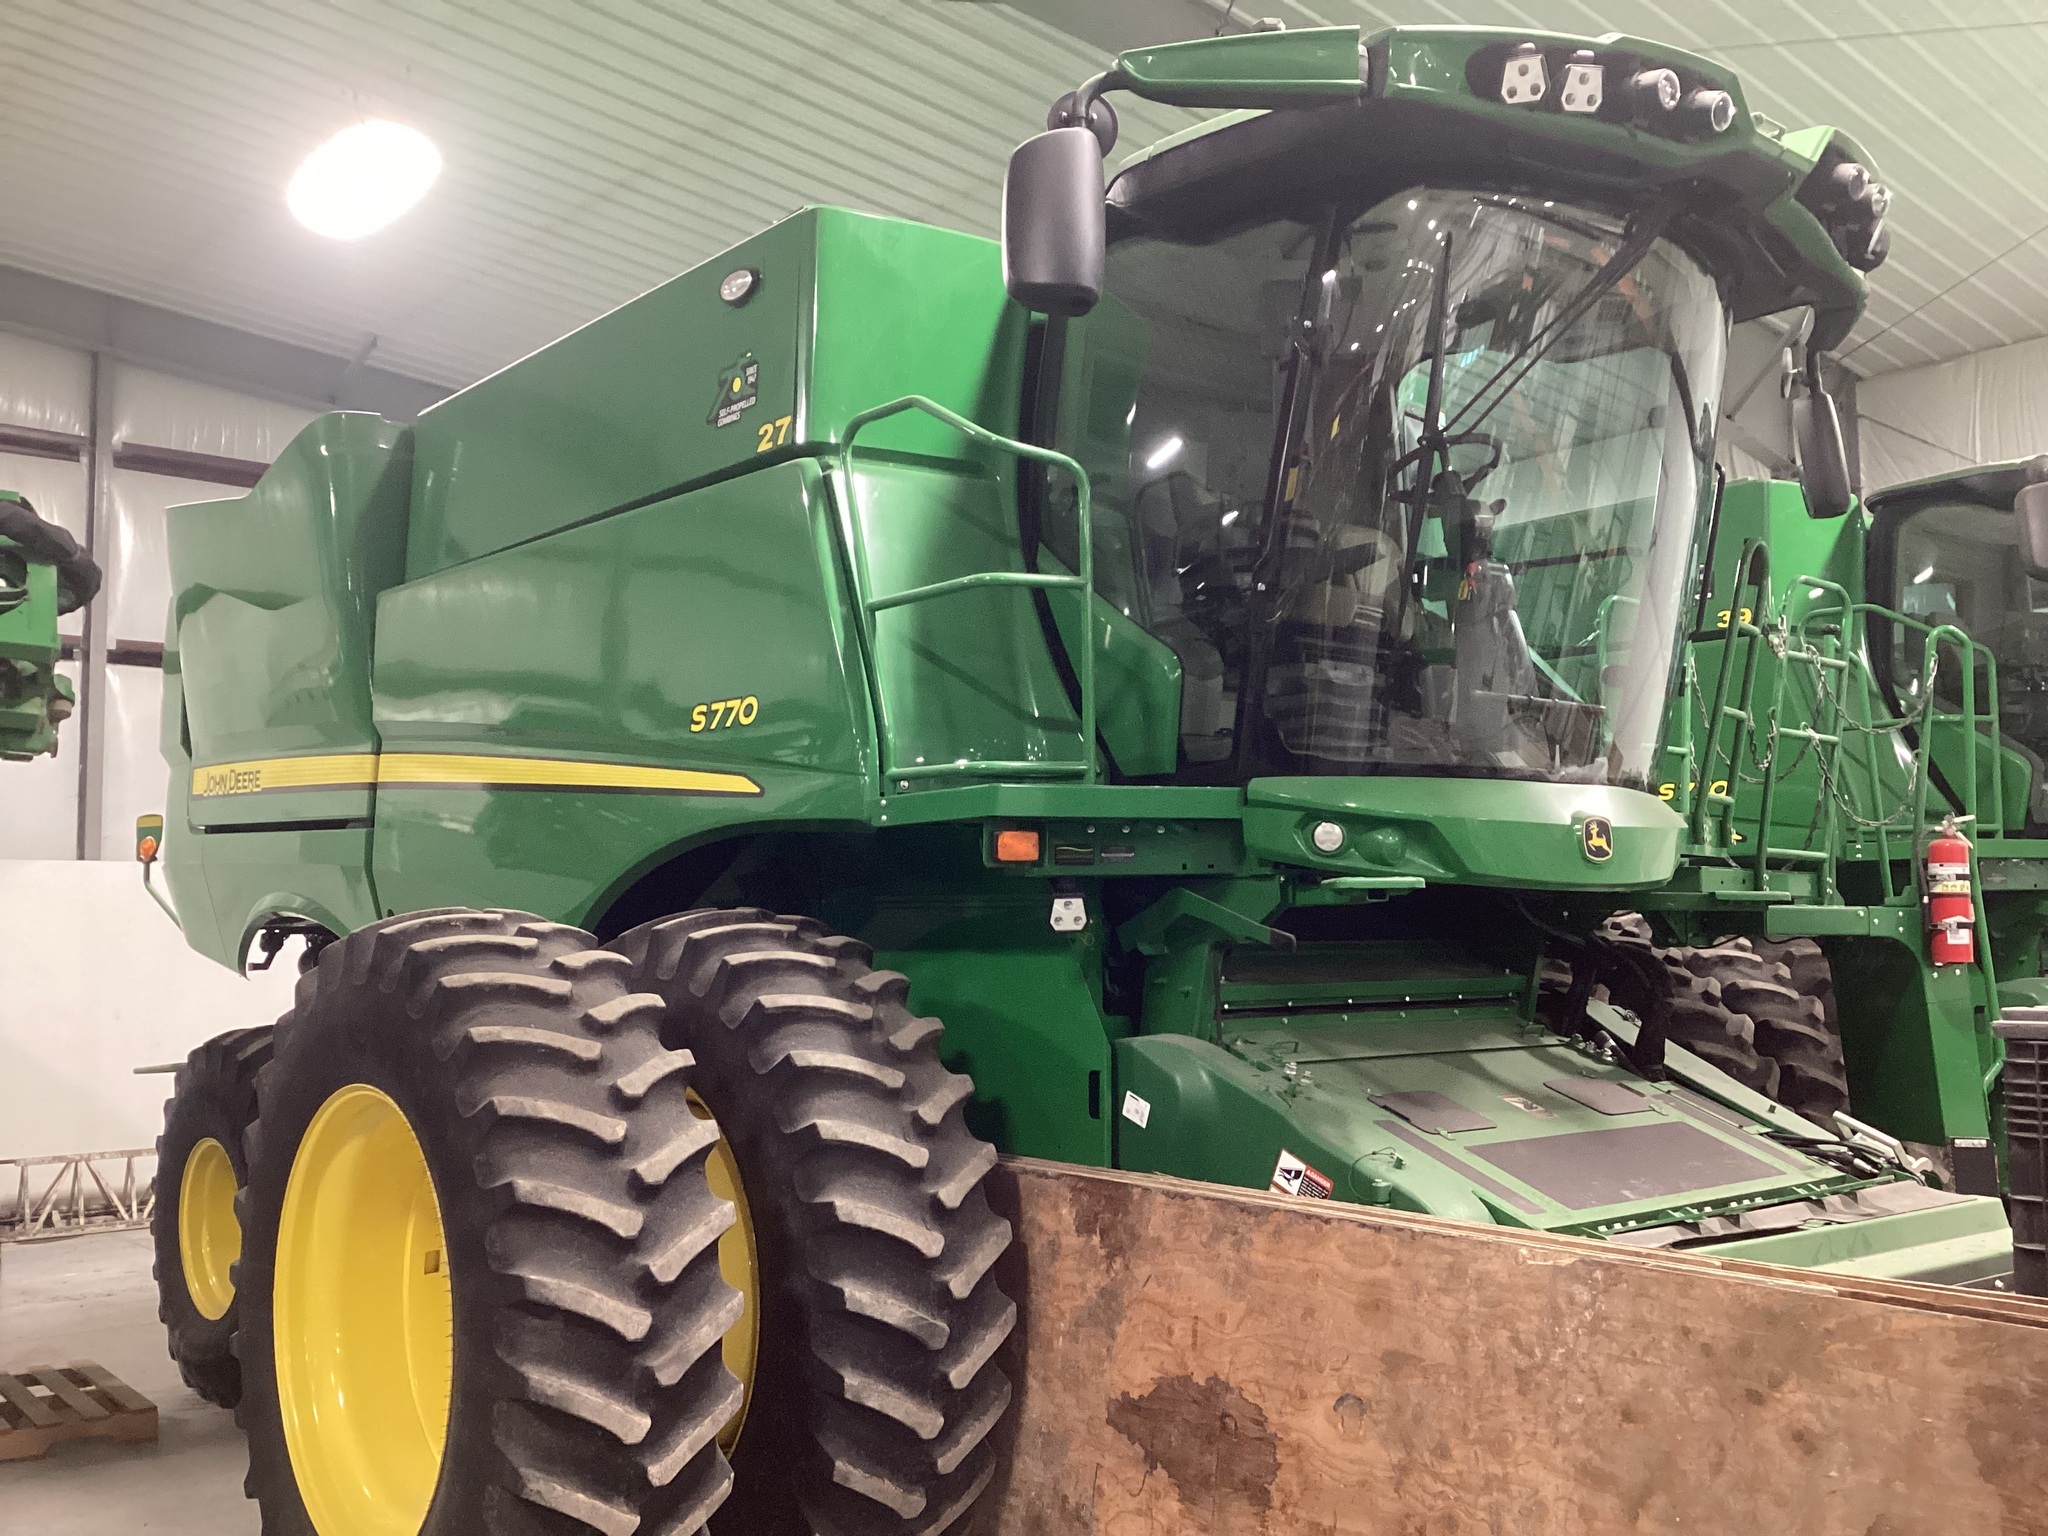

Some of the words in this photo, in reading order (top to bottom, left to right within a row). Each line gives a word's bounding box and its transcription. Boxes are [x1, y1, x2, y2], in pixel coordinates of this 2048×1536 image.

[756, 415, 792, 453] 27
[689, 695, 759, 733] S770
[203, 771, 229, 796] JOHN
[229, 769, 262, 793] DEERE
[1657, 780, 1728, 801] S0
